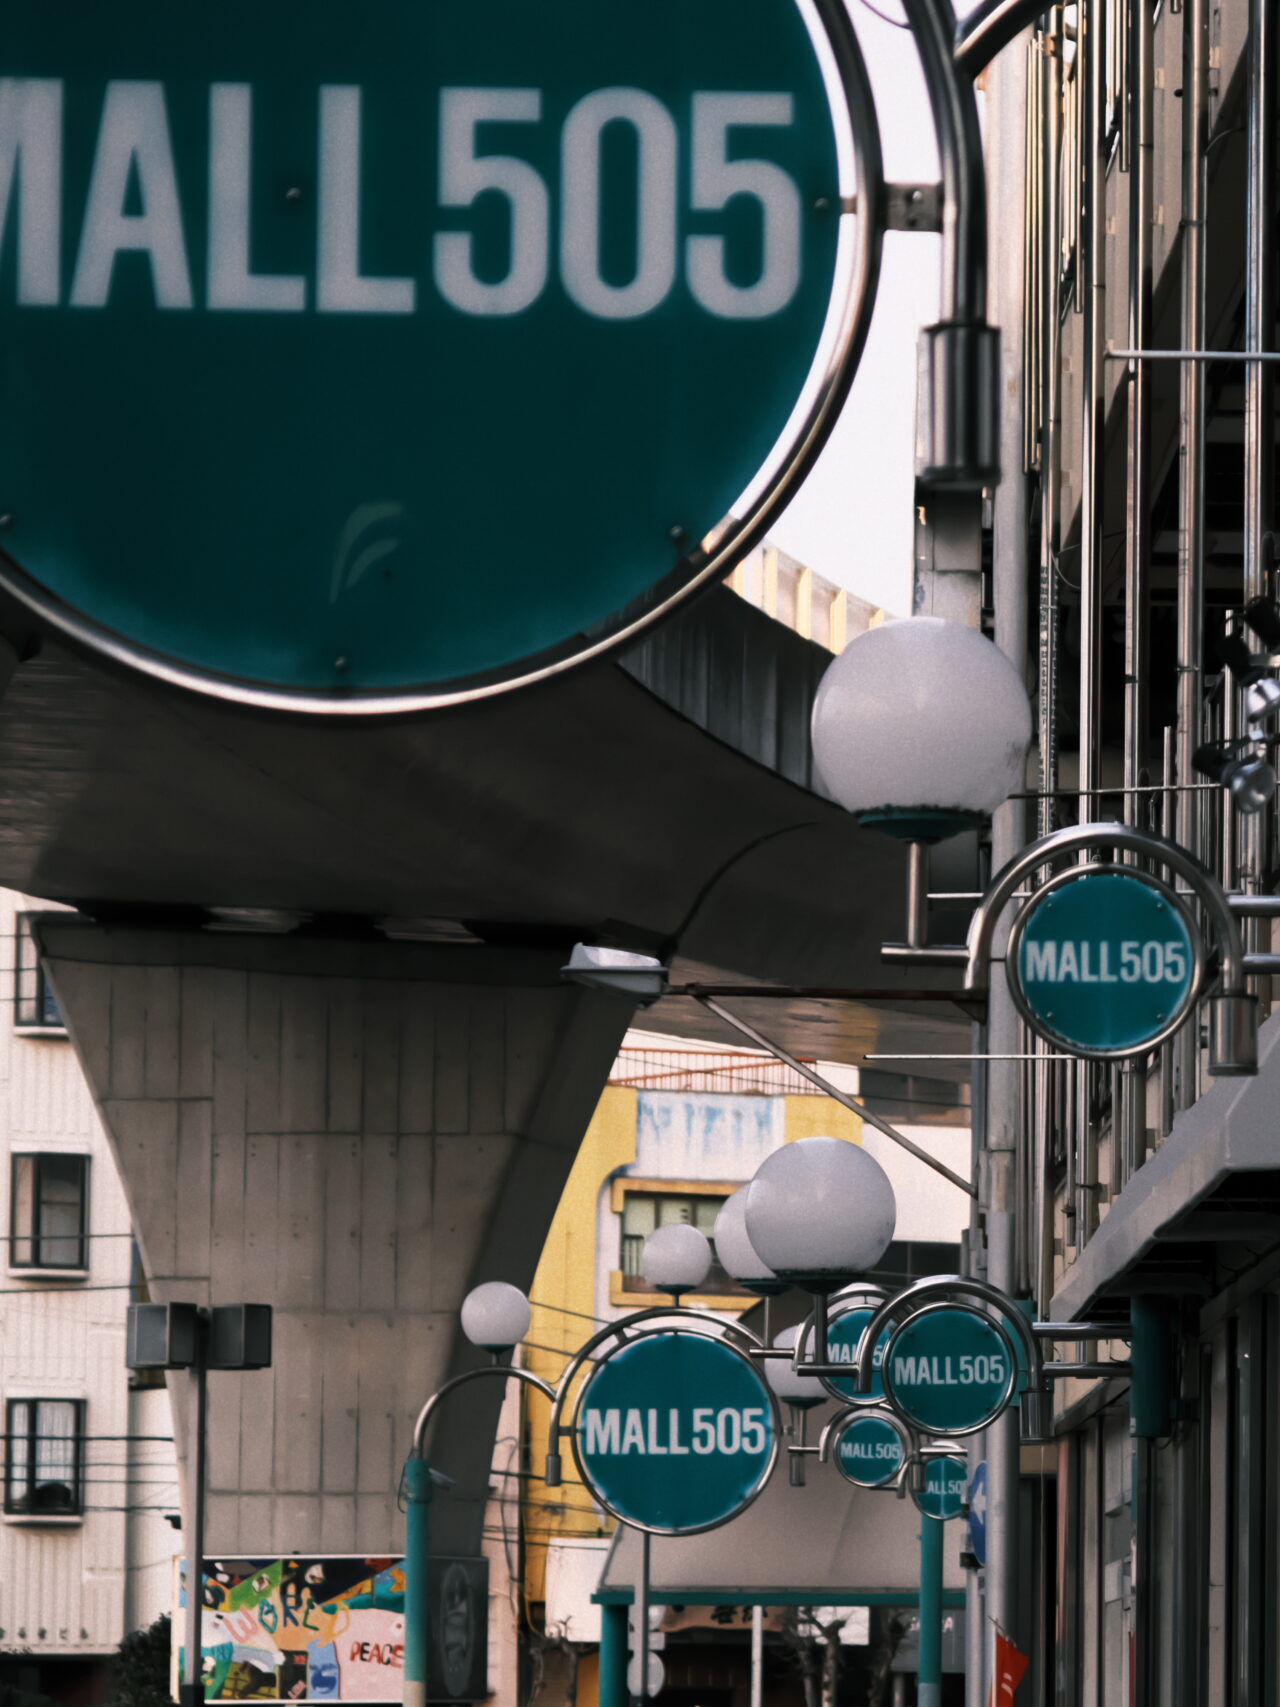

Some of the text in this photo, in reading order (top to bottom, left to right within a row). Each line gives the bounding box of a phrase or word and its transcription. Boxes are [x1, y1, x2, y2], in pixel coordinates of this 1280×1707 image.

[1024, 939, 1186, 984] MALL505
[894, 1354, 1005, 1386] MALL505
[585, 1407, 766, 1456] MALL505
[840, 1442, 901, 1460] MALL505
